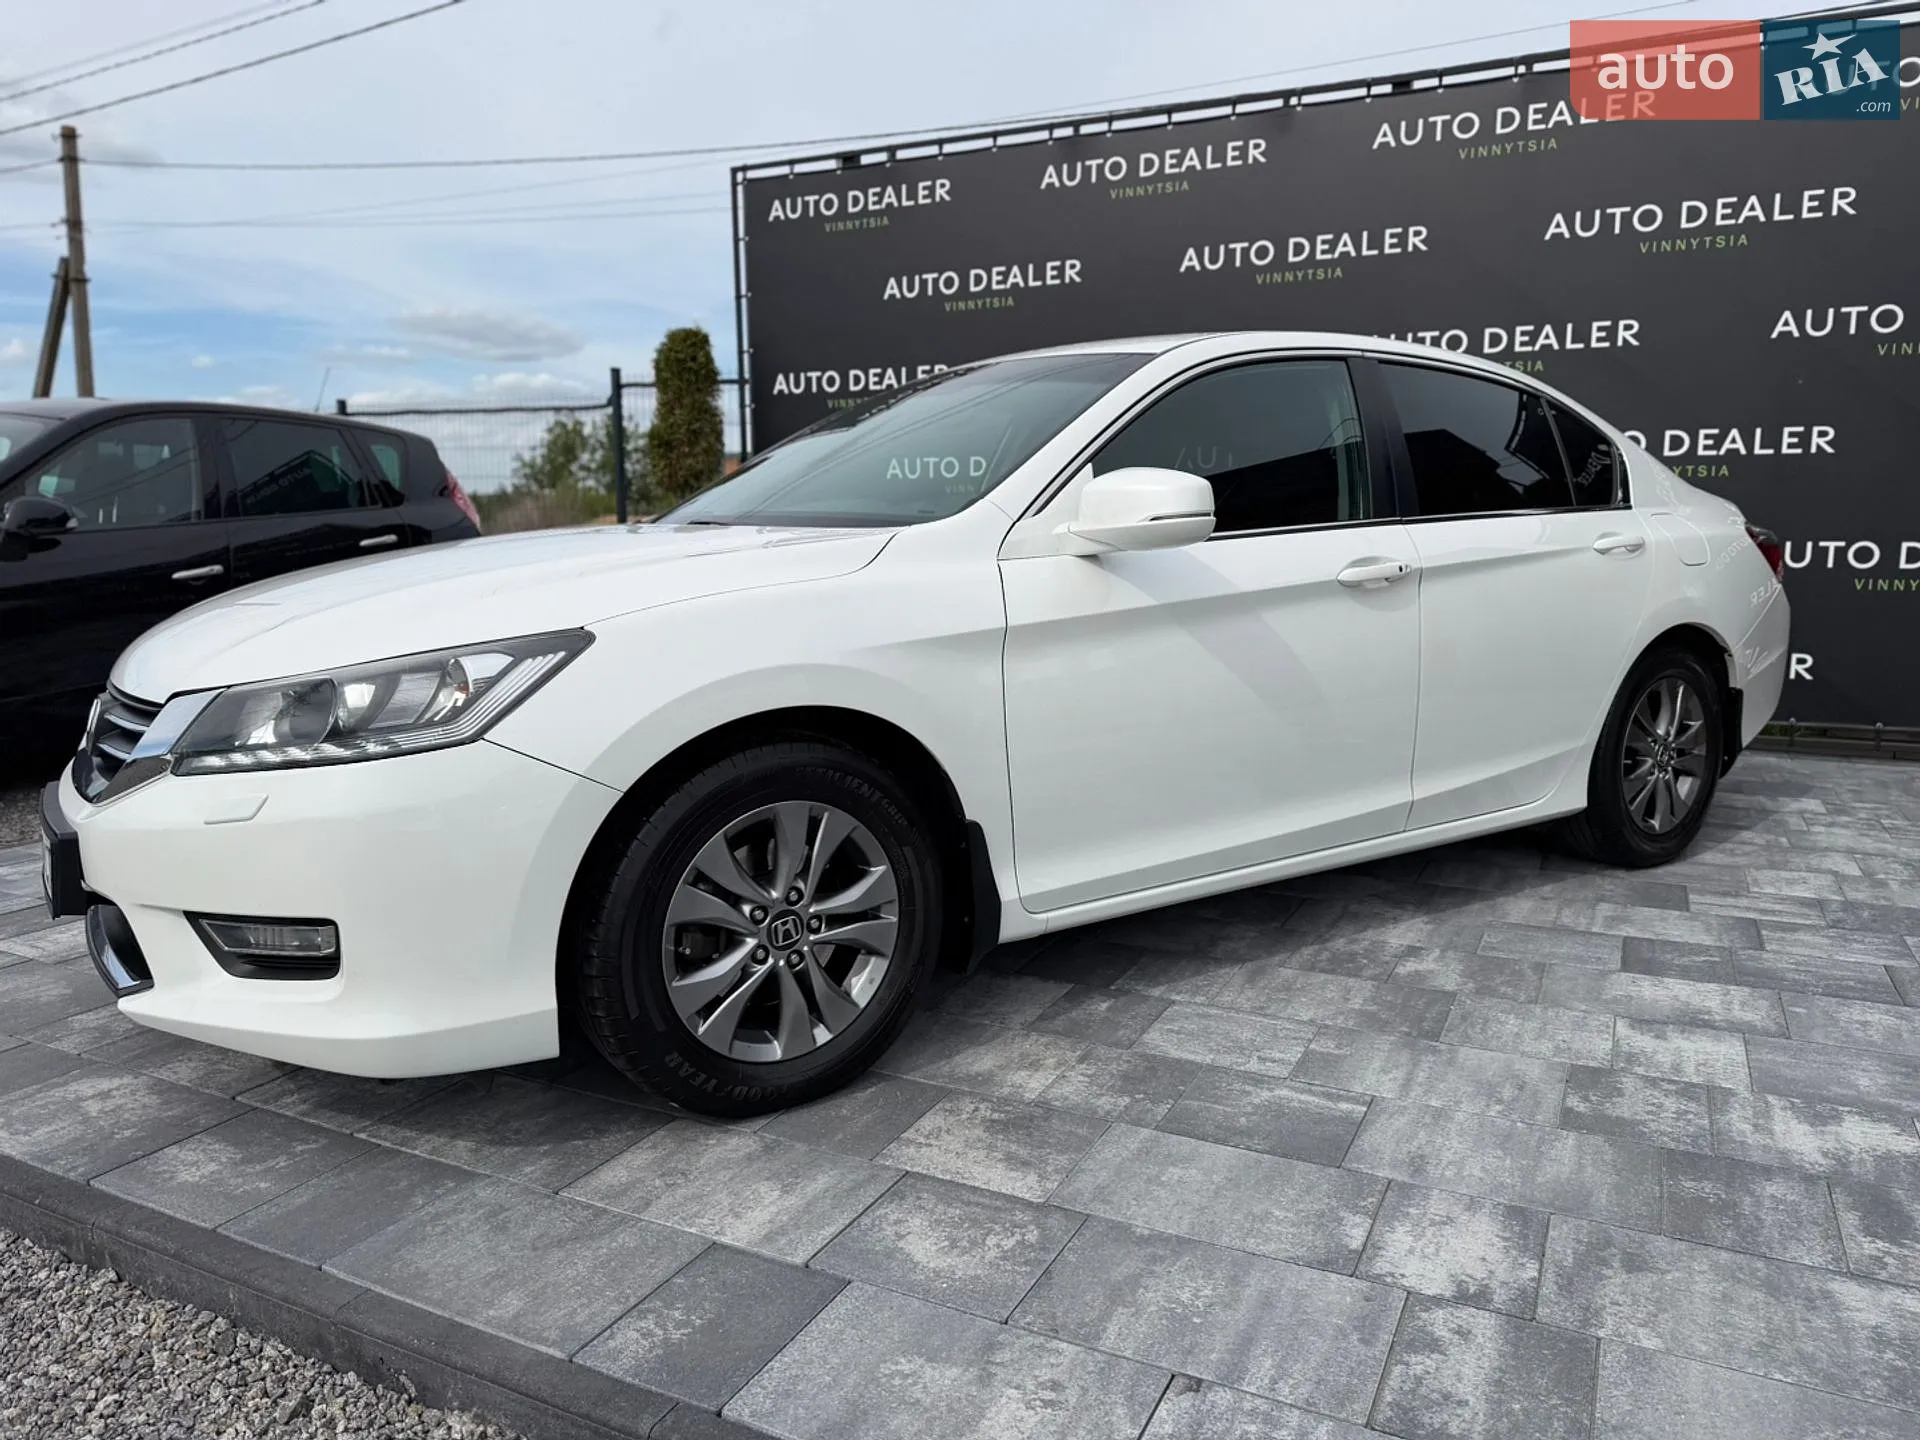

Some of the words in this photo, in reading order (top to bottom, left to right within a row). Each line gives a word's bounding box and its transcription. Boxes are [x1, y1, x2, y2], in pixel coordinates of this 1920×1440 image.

[1372, 112, 1480, 150] AUTO
[1459, 138, 1558, 159] VINNYTSIA
[1040, 155, 1127, 189] AUTO
[1138, 138, 1267, 178] DEALER
[767, 192, 839, 222] AUTO
[847, 178, 952, 213] DEALER
[1110, 181, 1190, 199] VINNYTSIA
[824, 216, 889, 232] VINNYTSIA
[1543, 203, 1663, 241] AUTO
[1680, 186, 1858, 229] DEALER
[1179, 239, 1275, 273] AUTO
[1287, 225, 1428, 263] DEALER
[1640, 234, 1749, 253] VINNYTSIA
[883, 271, 960, 300] AUTO
[969, 259, 1083, 292] DEALER
[1256, 267, 1343, 285] VINNYTSIA
[944, 296, 1015, 312] VINNYTSIA
[1770, 304, 1904, 339] AUTO
[1483, 319, 1640, 354] DEALER
[772, 370, 840, 395] AUTO
[1663, 426, 1836, 457] DEALER
[886, 456, 960, 479] AUTO
[1671, 464, 1729, 478] YTSIA
[1784, 541, 1880, 569] UTO
[1854, 577, 1920, 591] VINNY
